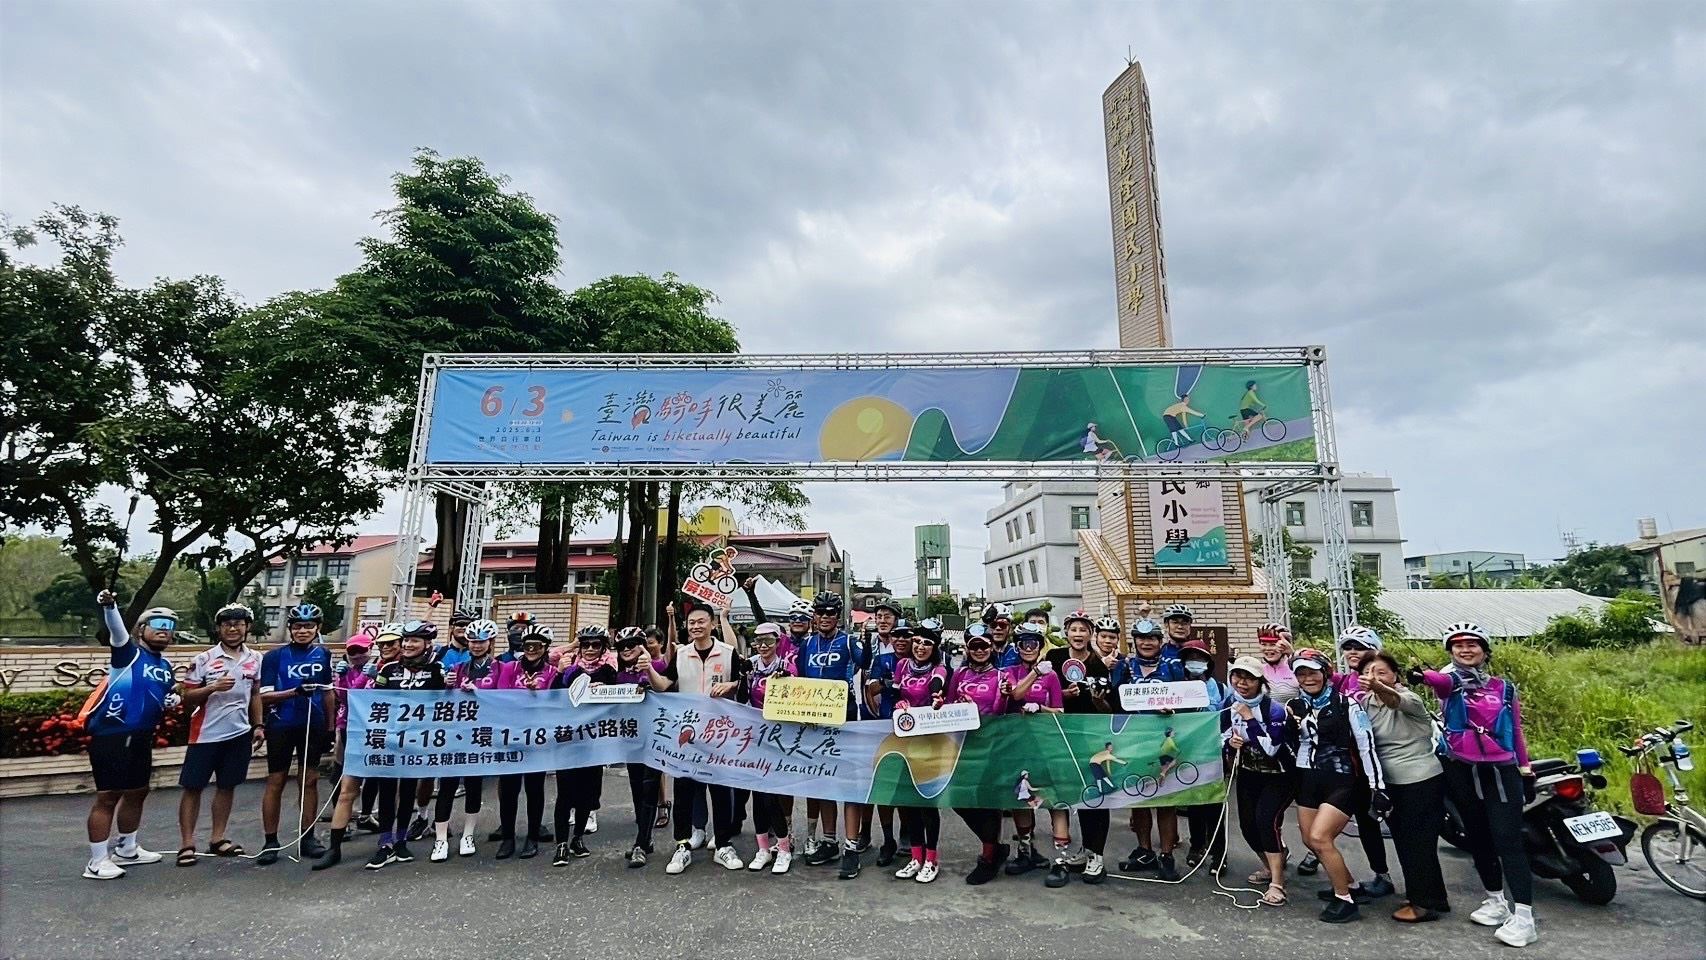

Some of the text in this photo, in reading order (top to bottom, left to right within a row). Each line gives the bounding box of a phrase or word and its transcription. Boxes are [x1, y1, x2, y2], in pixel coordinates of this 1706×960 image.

[1119, 145, 1145, 316] 萬隆國民小學
[591, 427, 801, 446] Taiwan is biketually beautiful
[808, 652, 841, 667] KCP
[142, 664, 173, 683] KCP
[287, 663, 323, 679] KCP
[900, 674, 927, 688] KCP
[956, 682, 990, 693] KCP
[1123, 686, 1169, 697] 屏東縣政府
[1147, 696, 1183, 705] 希望城市
[368, 701, 391, 723] 第
[397, 703, 426, 722] 24
[431, 700, 479, 721] 路段
[918, 709, 969, 721] 中華民國交通部
[364, 728, 388, 750] 環
[500, 728, 547, 746] 1-18
[553, 718, 639, 743] 替代路線
[400, 755, 423, 766] 185
[651, 739, 686, 761] Taiwan
[691, 752, 703, 764] is
[706, 752, 773, 778] biketually
[775, 759, 838, 778] beautiful
[1569, 817, 1617, 837] NEN-9585
